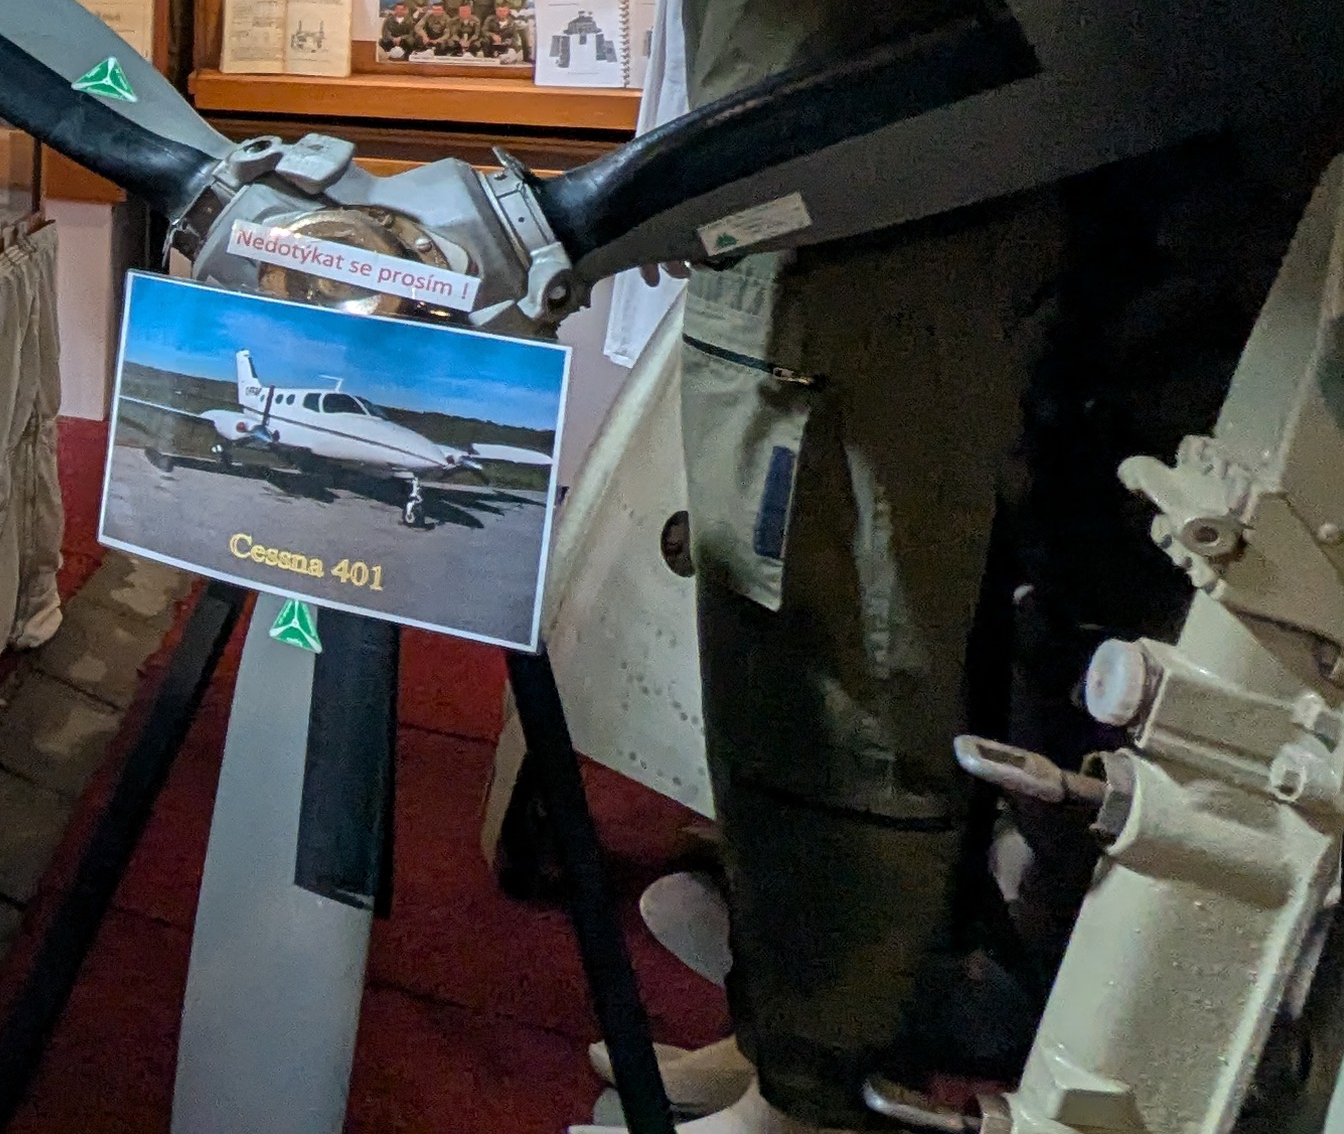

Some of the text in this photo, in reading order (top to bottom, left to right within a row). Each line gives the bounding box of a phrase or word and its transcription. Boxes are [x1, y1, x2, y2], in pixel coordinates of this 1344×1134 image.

[236, 228, 470, 300] Nedotýkat se prosím !
[229, 532, 385, 593] Cessna 401
